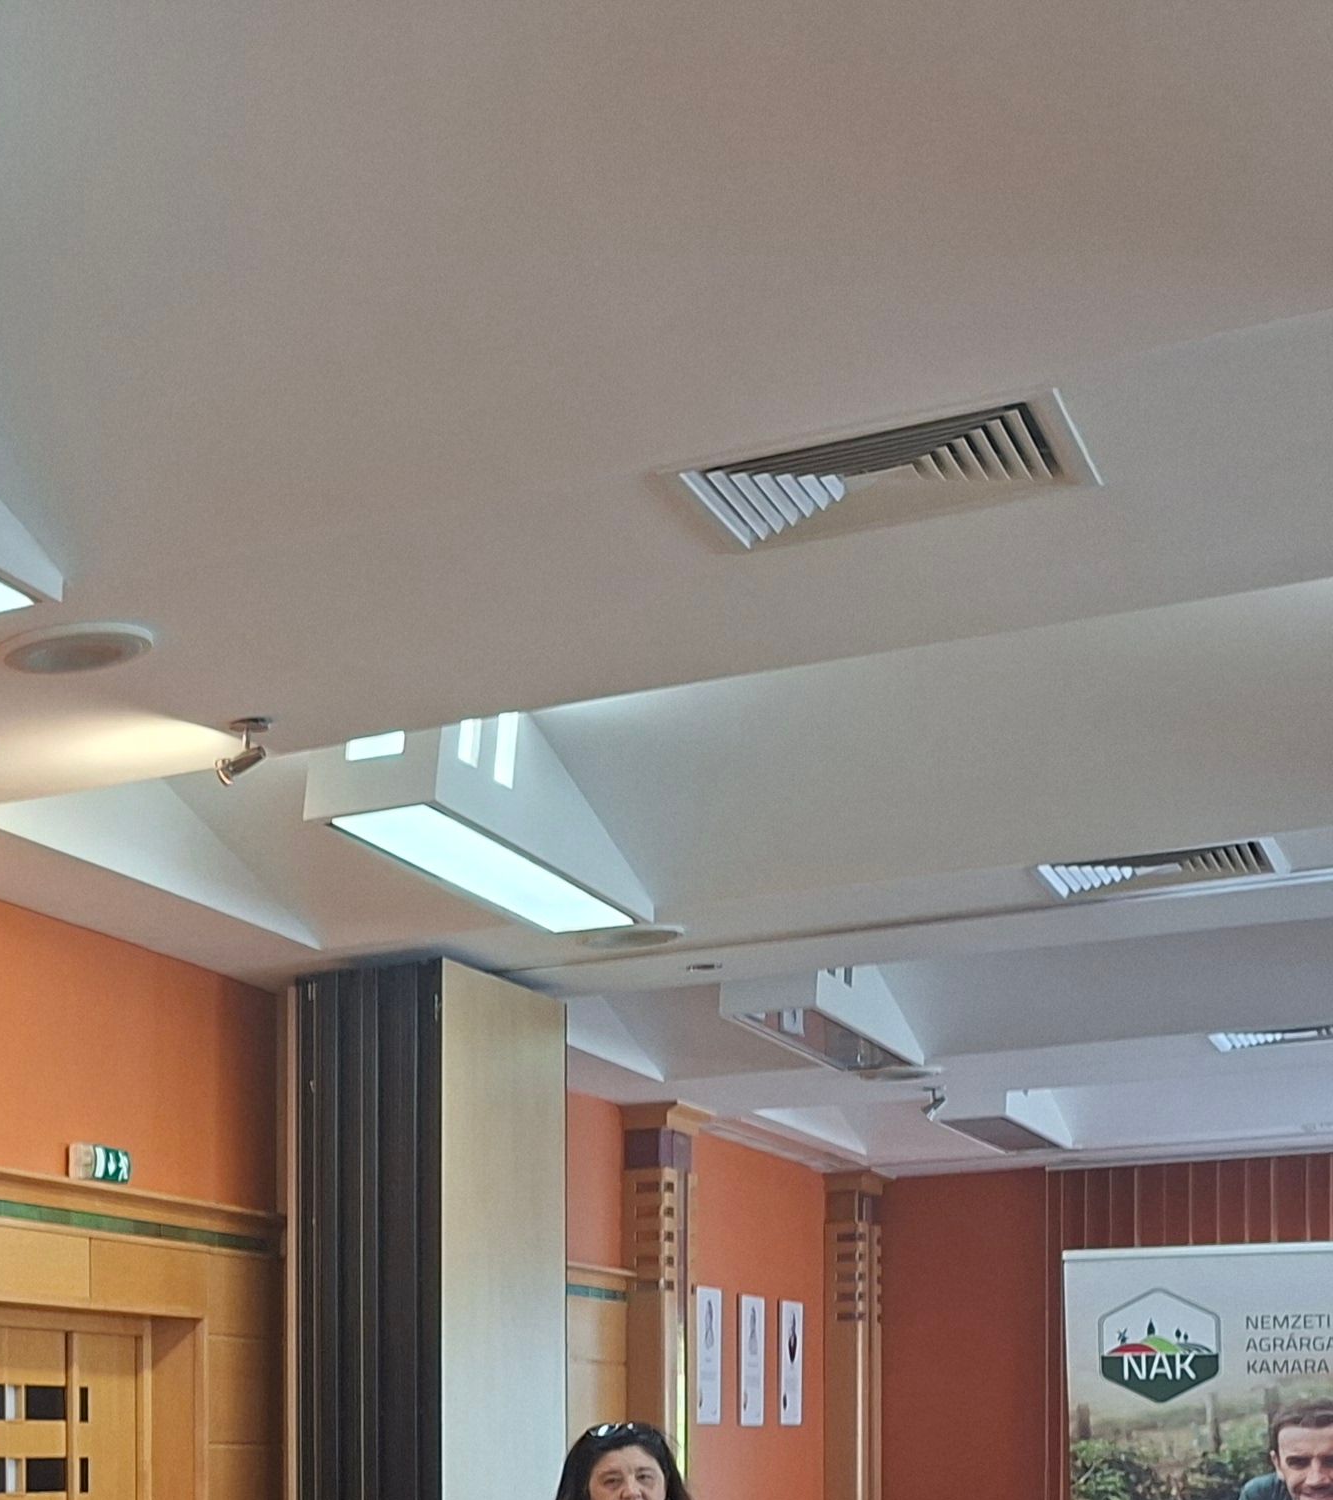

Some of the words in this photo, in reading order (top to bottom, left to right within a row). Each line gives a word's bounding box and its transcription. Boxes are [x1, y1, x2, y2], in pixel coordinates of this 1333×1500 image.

[1245, 1314, 1331, 1330] NEMZETI
[1122, 1351, 1197, 1382] NAK
[1246, 1358, 1330, 1374] KAMARA
